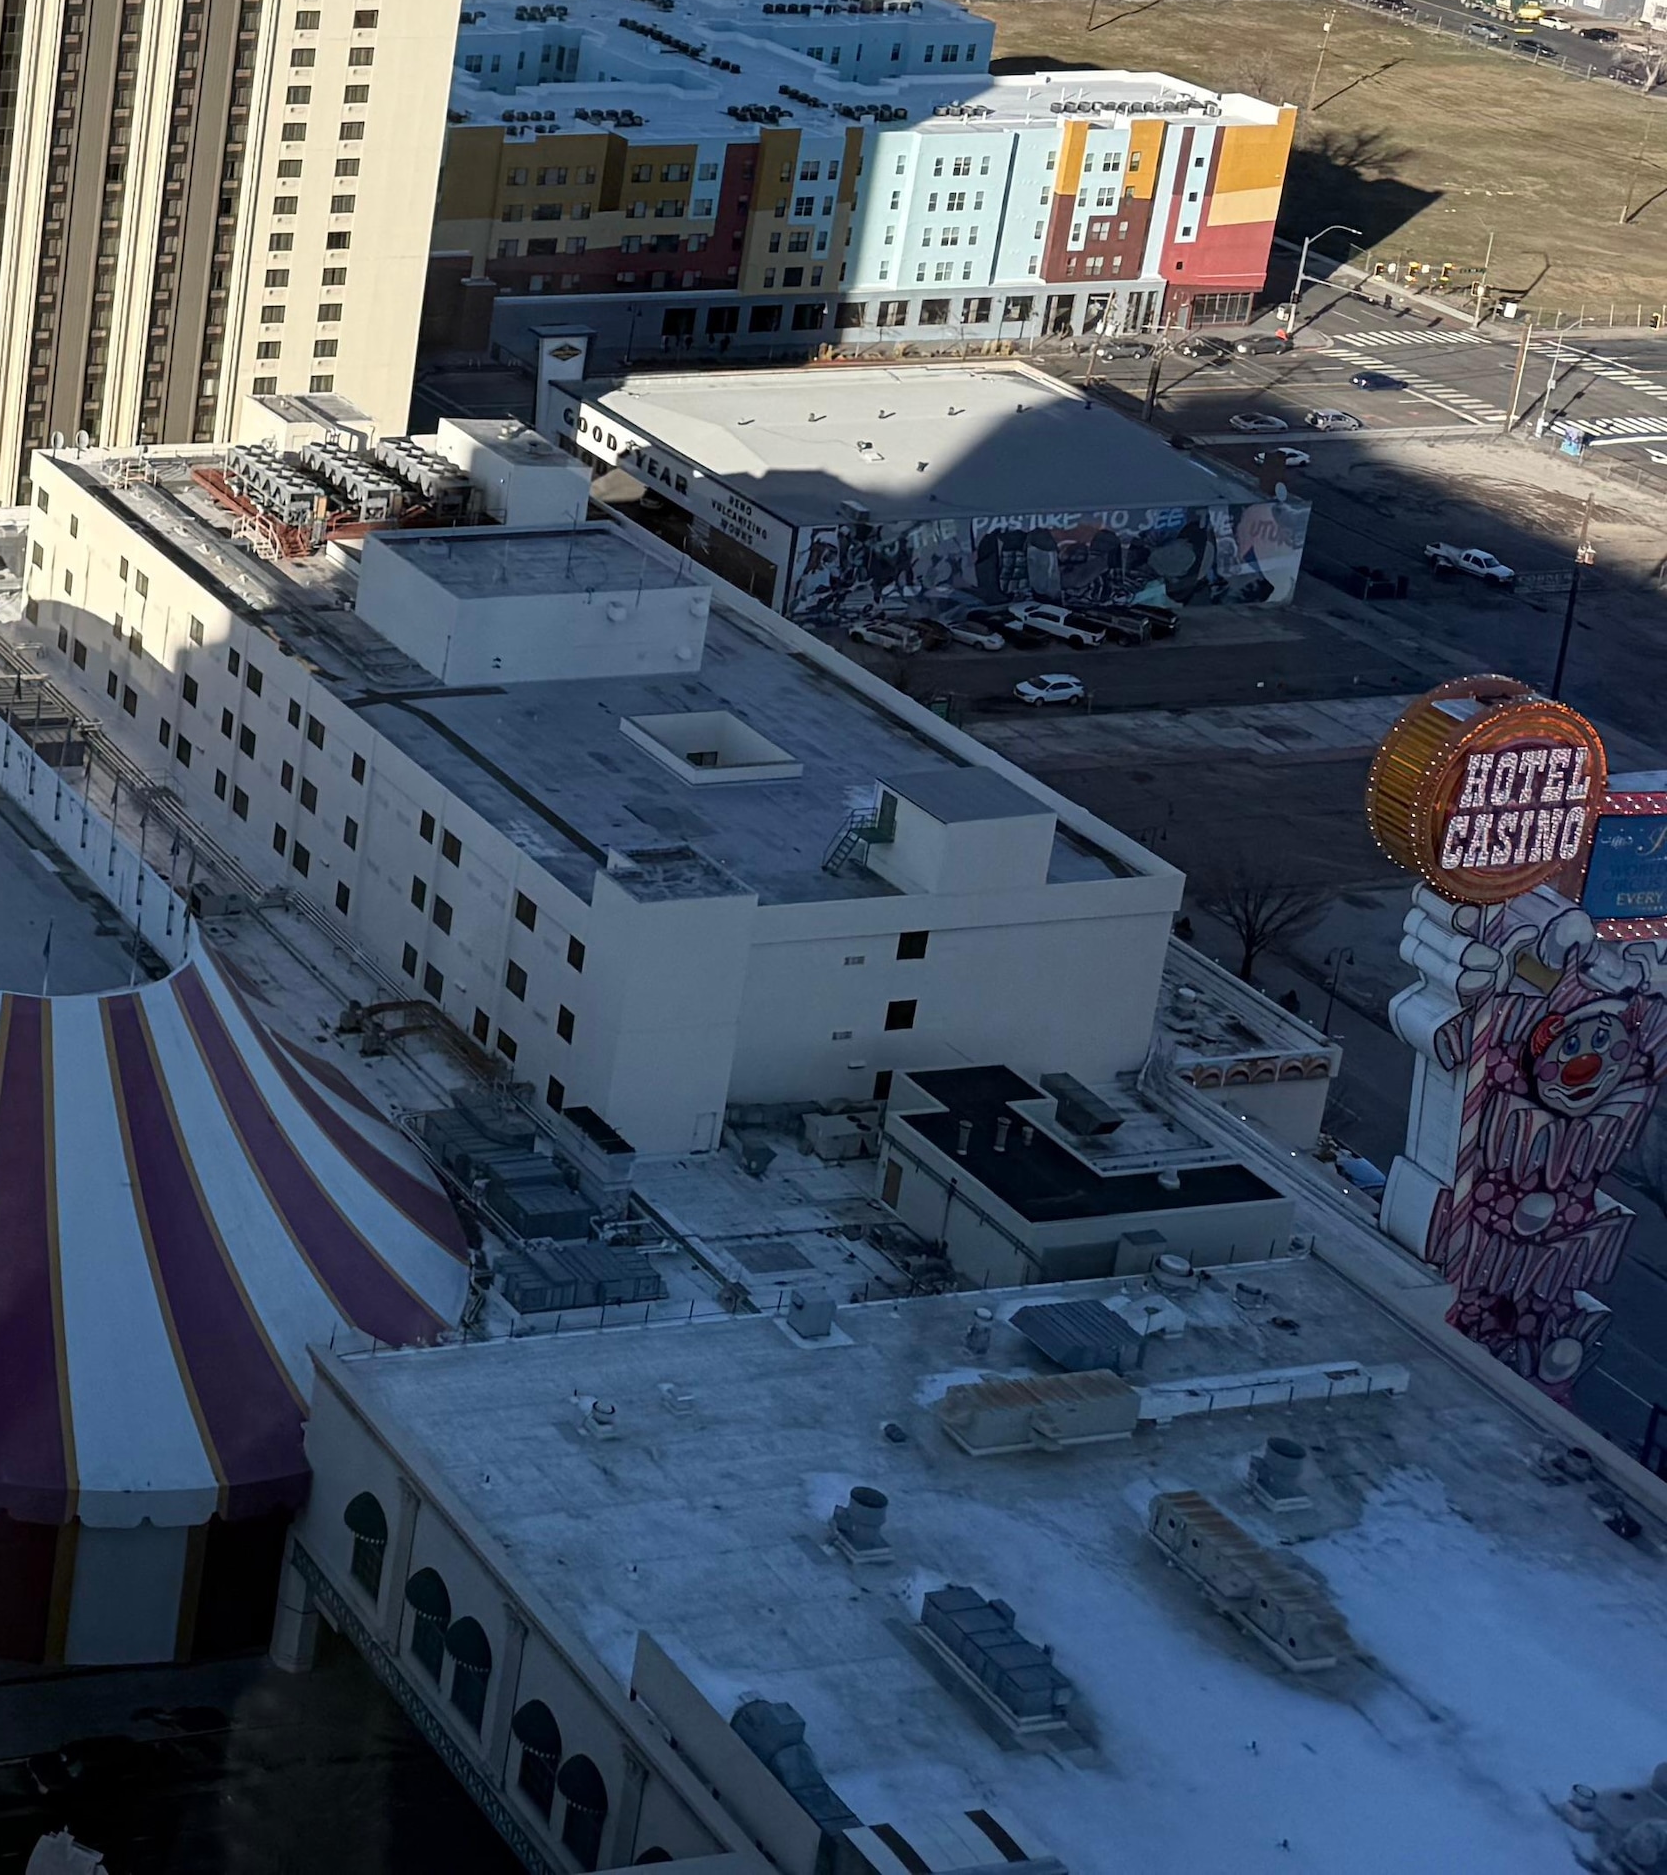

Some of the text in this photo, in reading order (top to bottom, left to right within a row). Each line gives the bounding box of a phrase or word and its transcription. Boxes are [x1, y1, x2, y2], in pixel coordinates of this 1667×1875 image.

[711, 498, 767, 540] VULCANIZING
[728, 494, 752, 516] RENO
[720, 518, 753, 545] WORKS
[1094, 509, 1129, 530] TO
[1137, 507, 1188, 531] SEE
[1195, 508, 1234, 535] THE
[1250, 520, 1304, 550] UTURE
[1459, 746, 1591, 809] HOTEL
[1441, 806, 1586, 870] CASINO
[1616, 891, 1664, 906] EVERY
